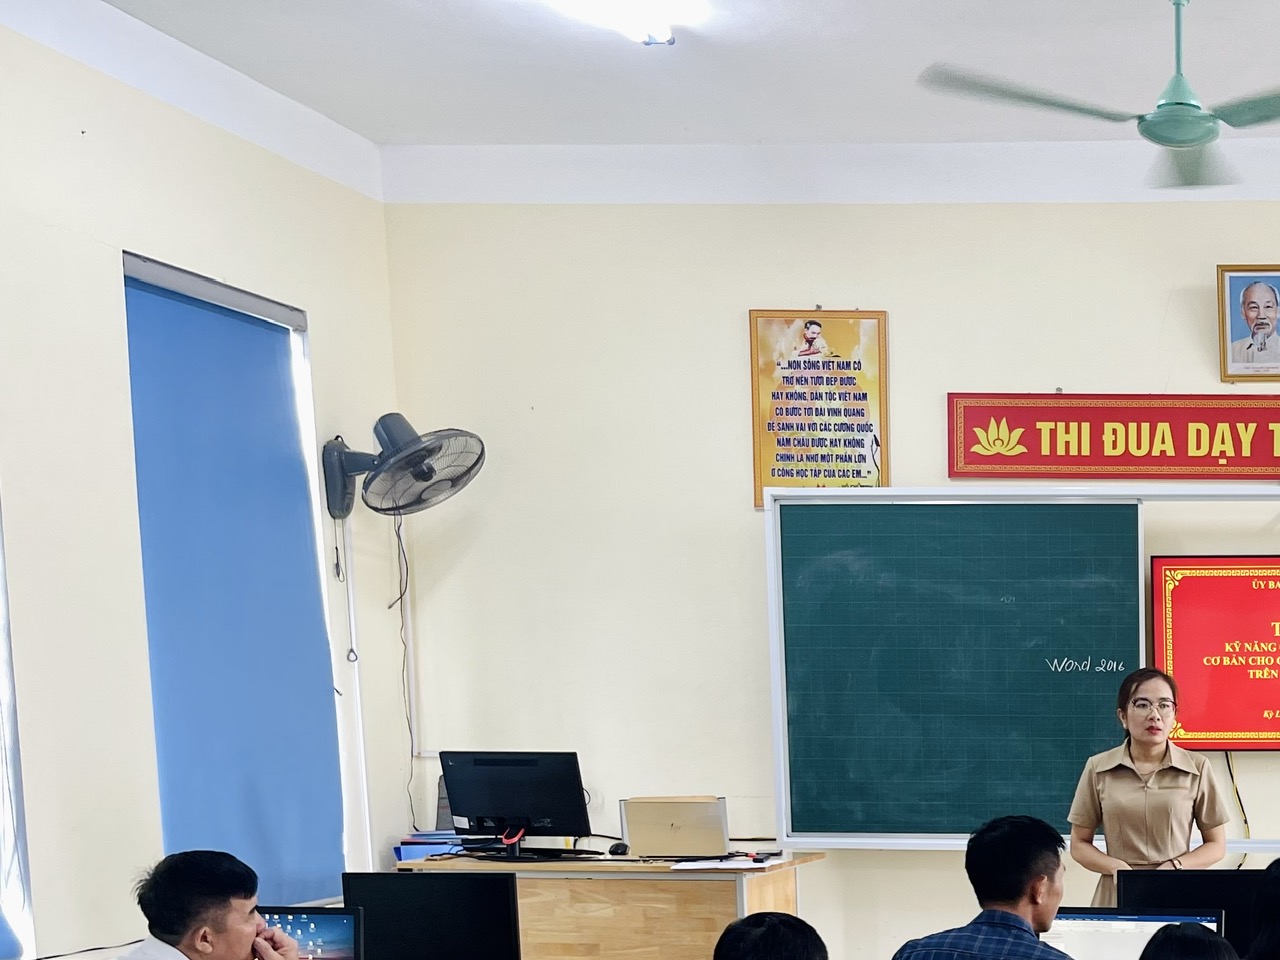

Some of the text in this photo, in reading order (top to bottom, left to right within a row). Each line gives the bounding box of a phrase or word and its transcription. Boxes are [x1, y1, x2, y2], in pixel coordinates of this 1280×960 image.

[836, 361, 852, 370] NAM
[772, 392, 784, 400] HAY
[852, 392, 868, 402] NAM
[827, 408, 842, 418] VINH
[844, 408, 864, 418] QUANG
[796, 422, 806, 432] VAI
[830, 438, 843, 448] HAY
[1036, 421, 1092, 457] THI
[1102, 421, 1176, 457] ĐUA
[1187, 421, 1257, 465] DẠY
[1252, 578, 1268, 590] ỦY
[1244, 640, 1278, 652] NĂNG
[1045, 656, 1125, 672] Word 2016
[1203, 656, 1222, 666] CƠ
[1248, 656, 1275, 666] CHO
[1248, 668, 1279, 679] TRÊN
